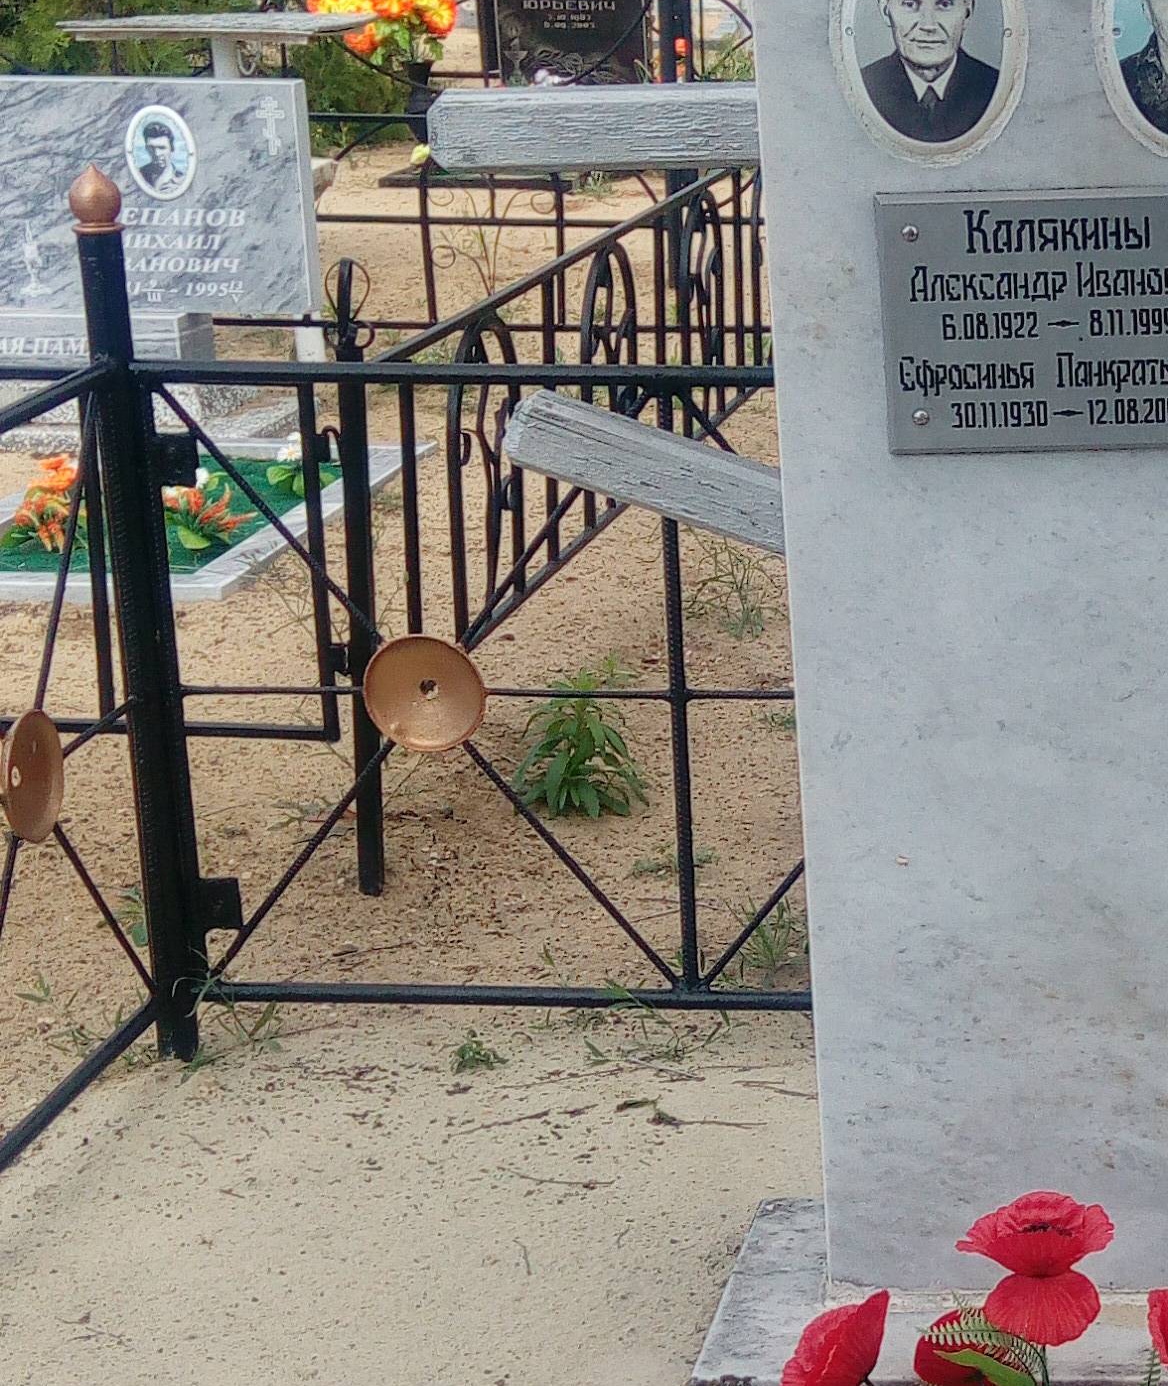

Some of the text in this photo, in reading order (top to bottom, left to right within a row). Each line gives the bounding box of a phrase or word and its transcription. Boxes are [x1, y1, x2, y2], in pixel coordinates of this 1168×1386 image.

[522, 0, 616, 11] ЮРЬЕВИЧ
[120, 207, 246, 227] ЕПАНОВ
[963, 210, 1151, 253] Калякины
[124, 234, 222, 250] ИХАИЛ
[910, 265, 1068, 303] Александр
[941, 311, 1039, 341] 6.08.1922
[899, 355, 1035, 397] Ефросинья
[951, 400, 1049, 429] 30.11.1930
